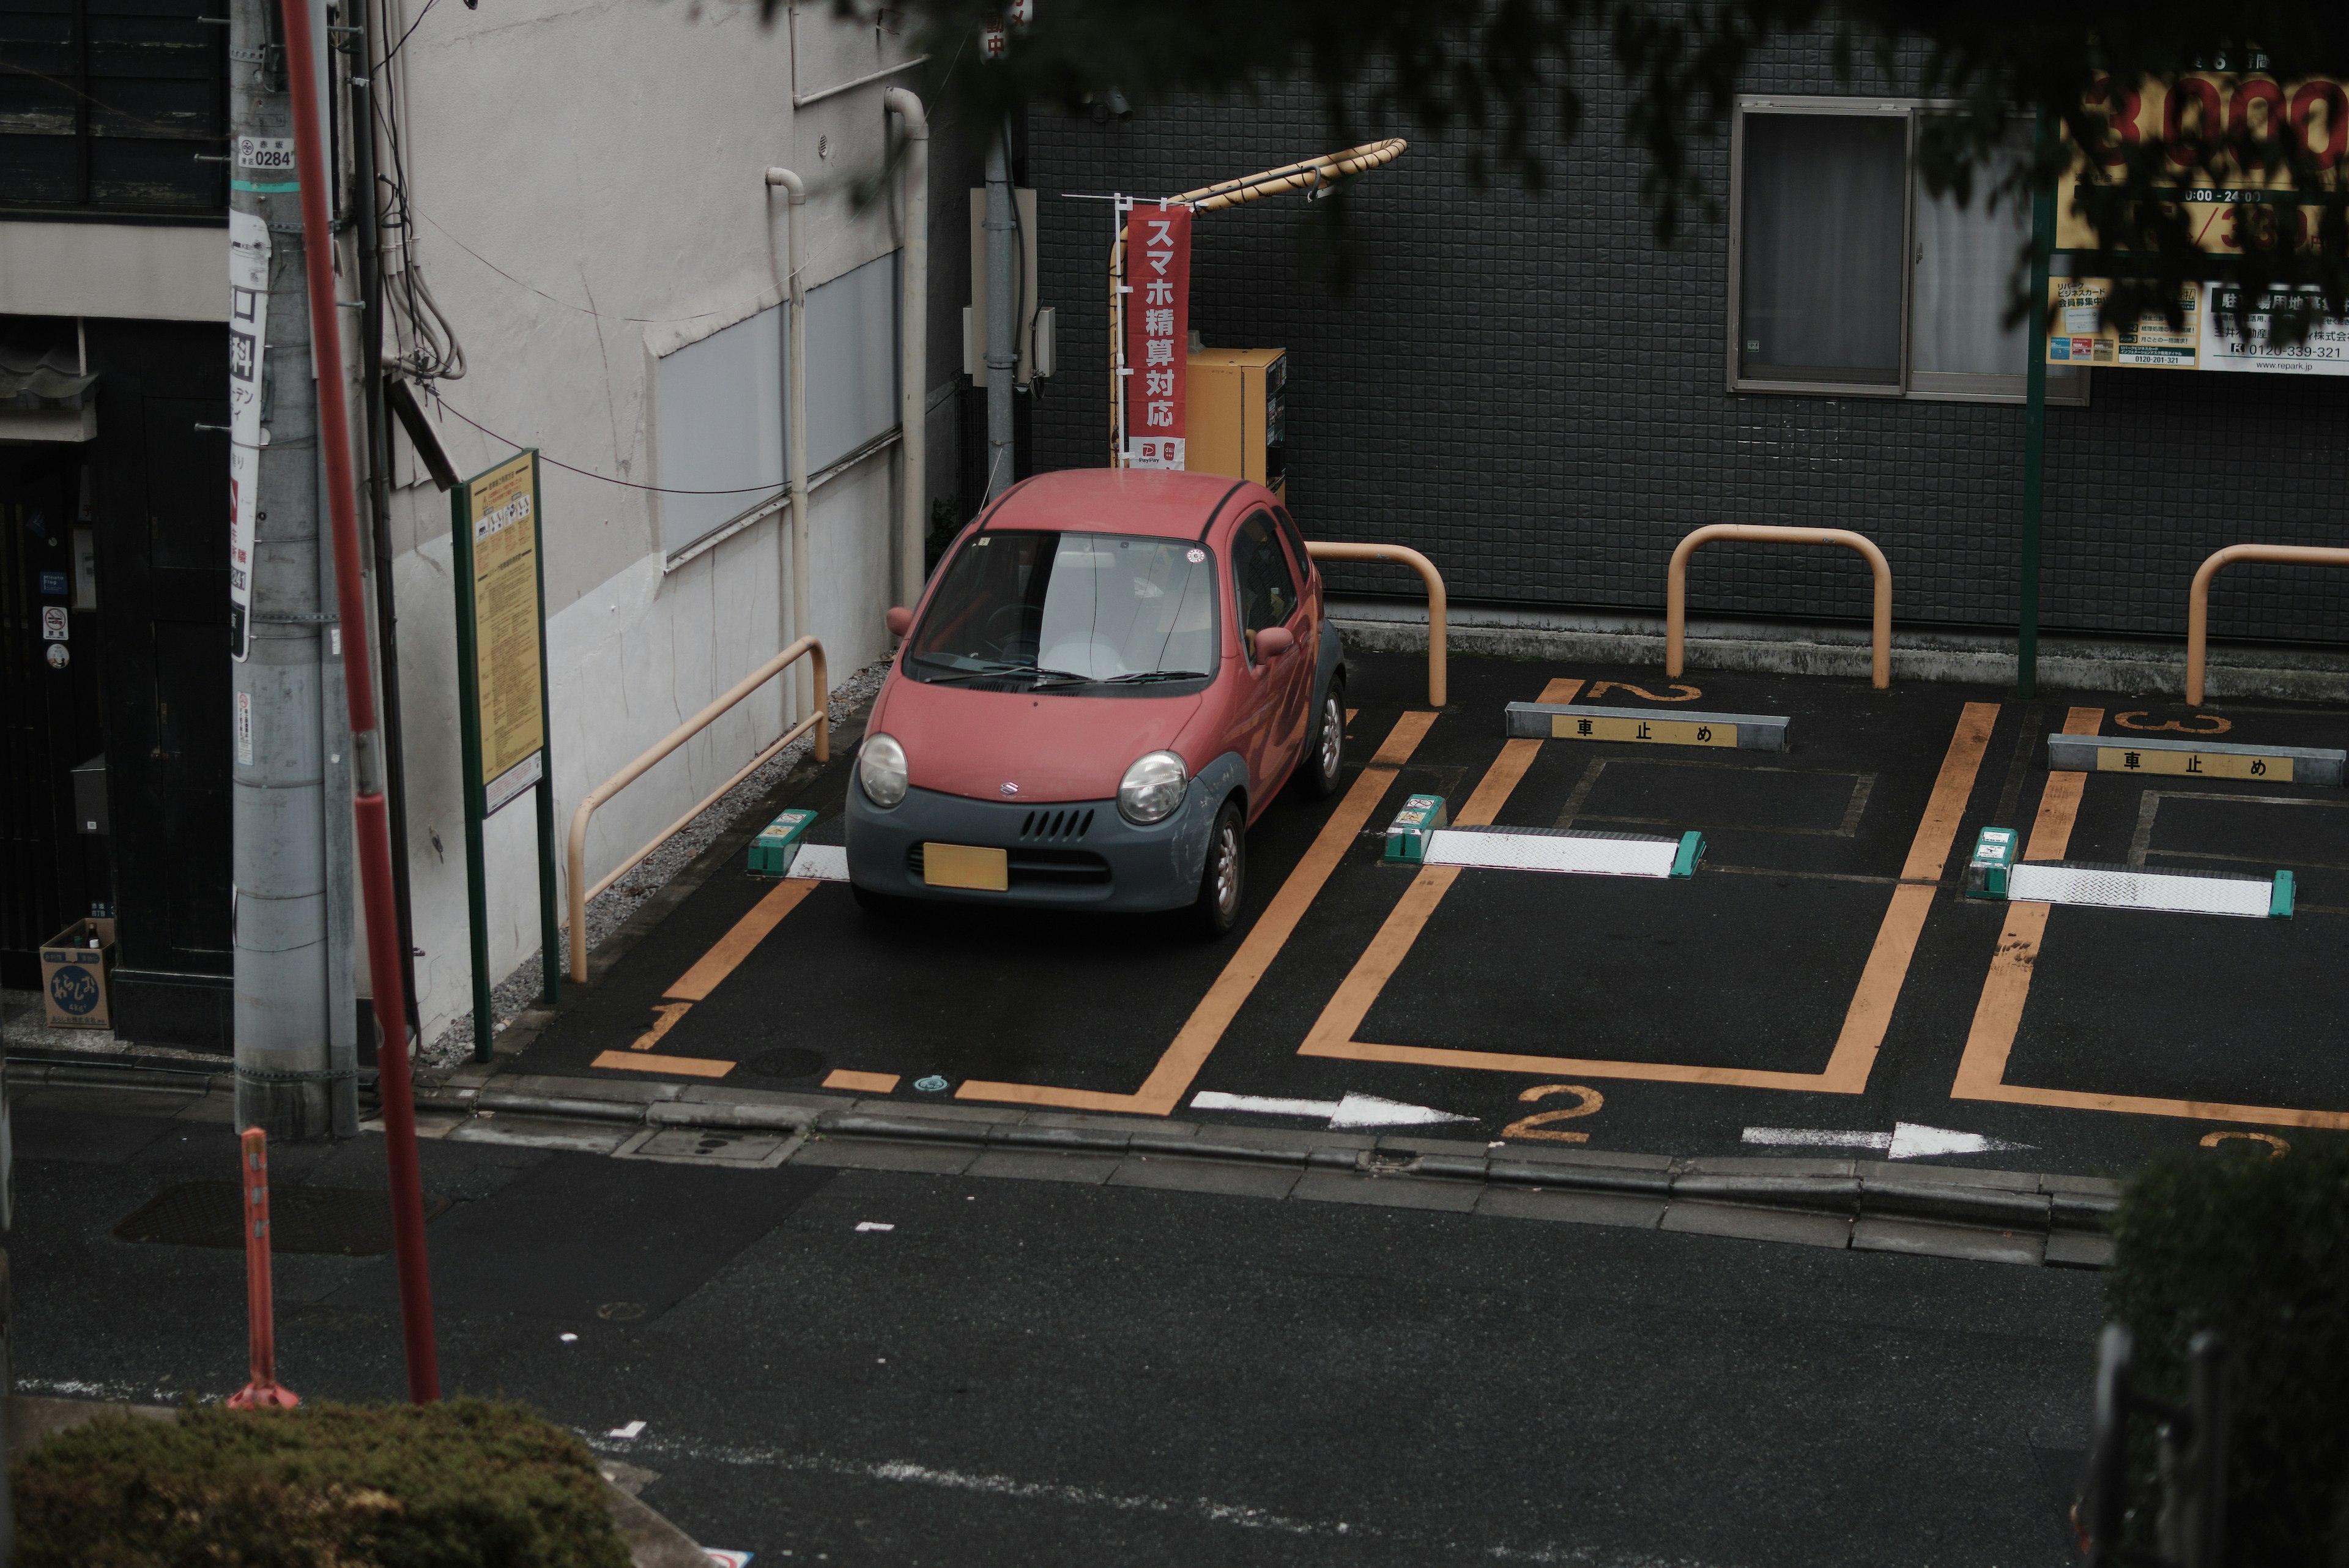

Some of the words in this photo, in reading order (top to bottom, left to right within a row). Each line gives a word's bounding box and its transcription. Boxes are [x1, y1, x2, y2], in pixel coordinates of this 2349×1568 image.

[256, 151, 290, 166] 0284
[2058, 288, 2106, 297] ビジネスカード
[1146, 220, 1174, 427] スマホ精算対応
[2249, 344, 2340, 358] 0120-339-321
[2256, 362, 2313, 372] www.repark.jp
[1577, 719, 1712, 743] 車止め
[2124, 752, 2266, 776] 車止め
[53, 973, 95, 1000] あらしお
[1501, 1083, 1606, 1144] 2
